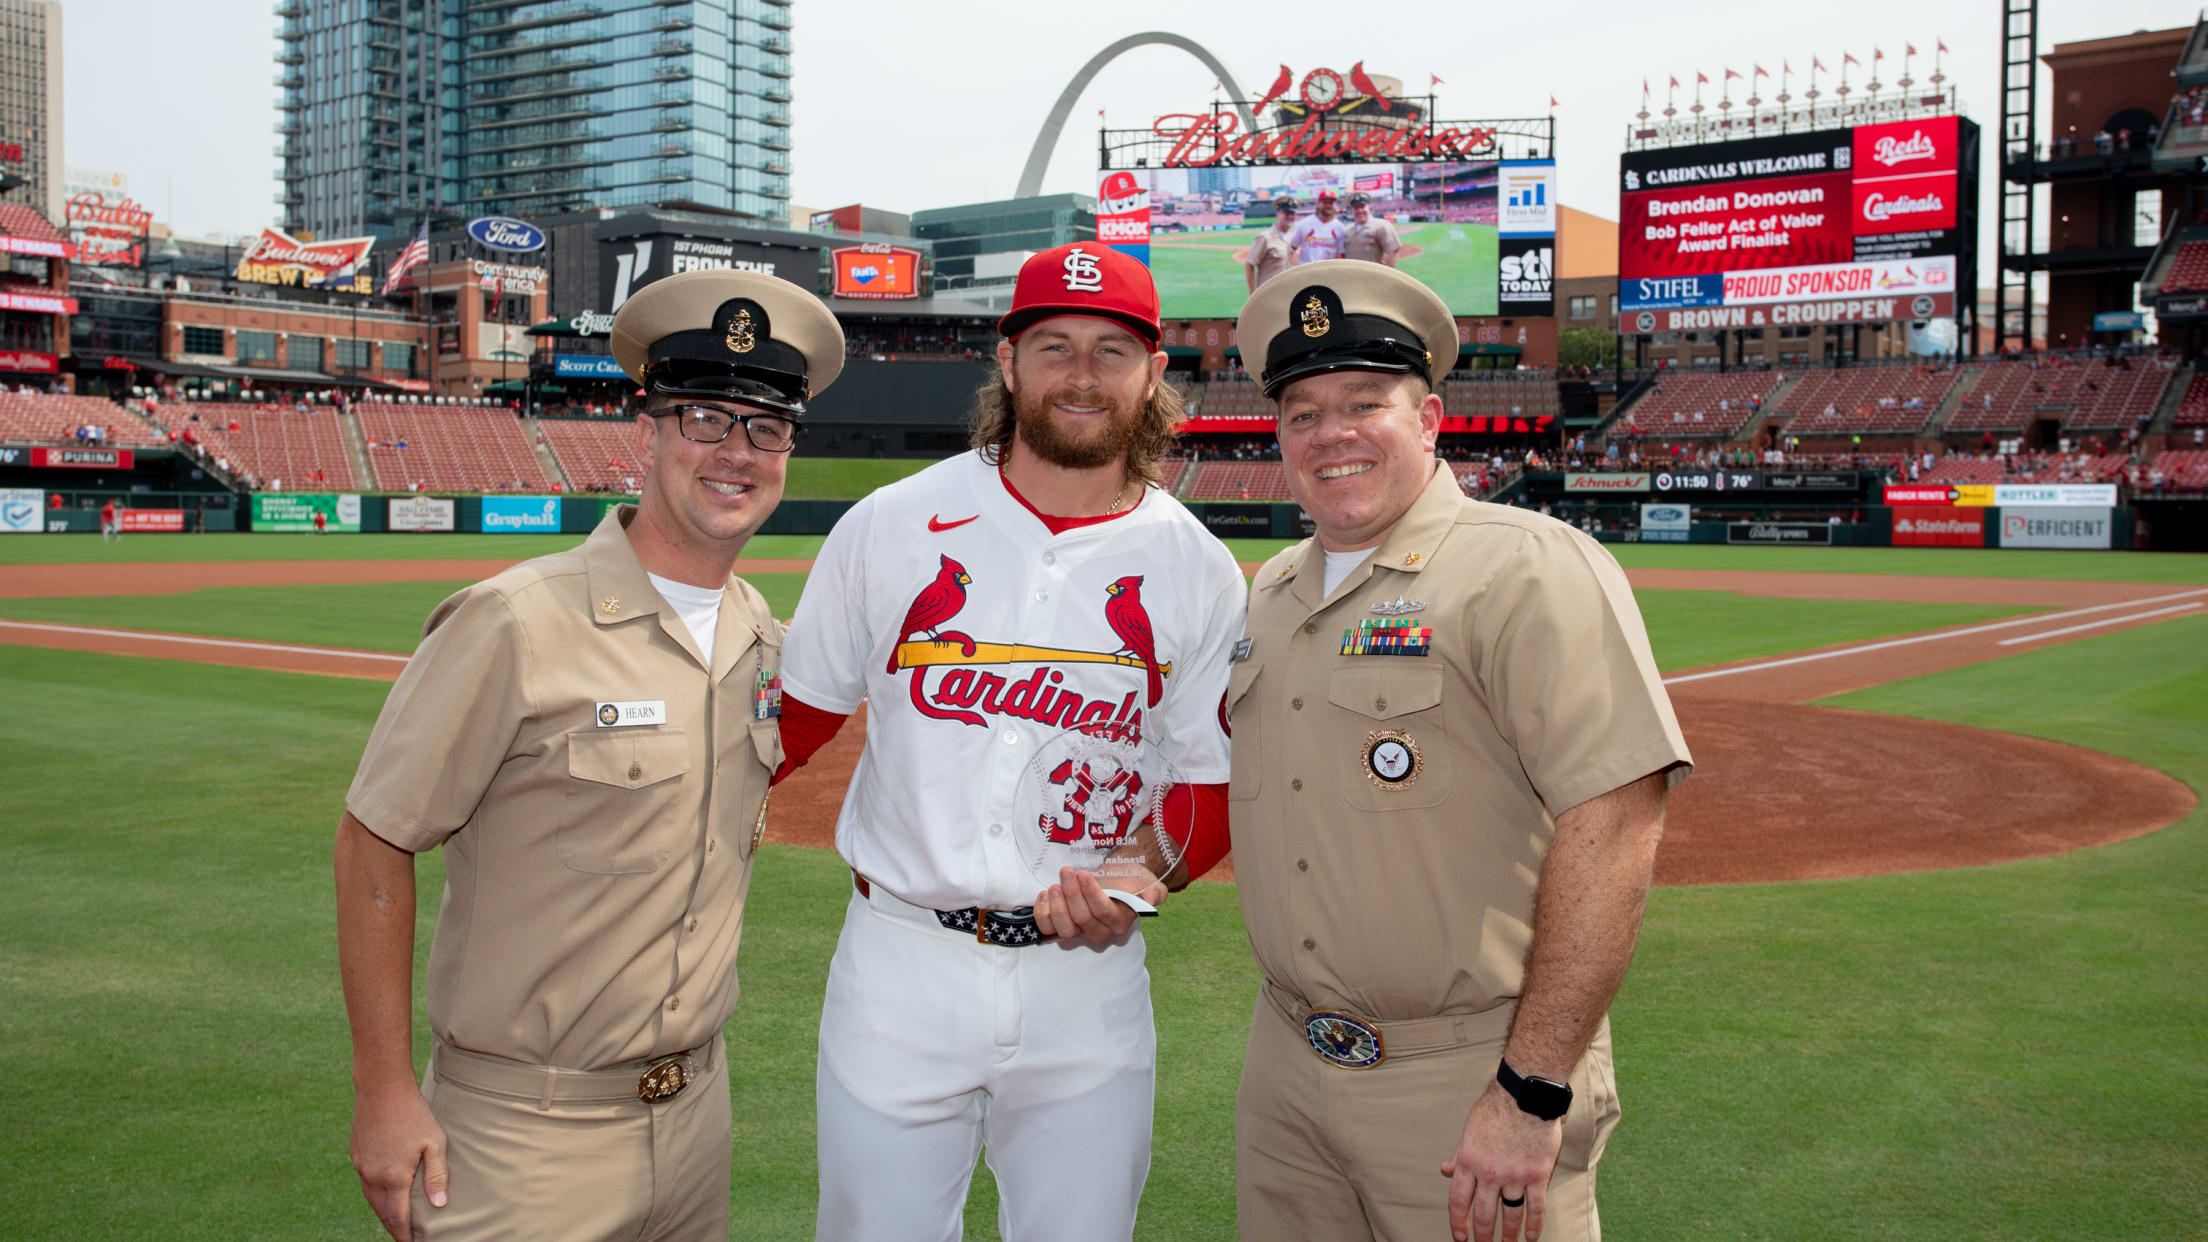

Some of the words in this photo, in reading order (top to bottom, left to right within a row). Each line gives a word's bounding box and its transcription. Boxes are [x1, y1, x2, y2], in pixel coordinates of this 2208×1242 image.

[1656, 117, 1749, 141] WORLD
[1754, 99, 1922, 130] CHAMPIONS
[1154, 111, 1497, 167] Budweiser
[1873, 129, 1936, 164] Reds
[1645, 164, 1738, 185] CARDINALS
[1740, 153, 1826, 176] WELCOME
[66, 192, 153, 236] Bally
[1530, 208, 1547, 216] Mid
[1648, 195, 1729, 217] Brendan
[1733, 187, 1824, 209] Donovan
[1863, 192, 1943, 221] Cardinals
[484, 219, 531, 247] Ford
[1099, 222, 1149, 235] KMOX
[1645, 225, 1677, 240] Bob
[1680, 220, 1725, 237] Feller
[1728, 217, 1756, 234] Act
[1759, 213, 1778, 231] of
[1781, 212, 1825, 229] Valor
[81, 241, 142, 267] Live!
[674, 240, 691, 253] 1ST
[691, 242, 734, 257] PHORM
[1677, 235, 1728, 254] Award
[1731, 231, 1790, 249] Finalist
[237, 261, 299, 286] BREW
[672, 253, 732, 275] FROM
[735, 260, 776, 276] THE
[1500, 247, 1552, 281] stl
[1500, 281, 1552, 292] TODAY
[1639, 277, 1704, 300] STIFEL
[1723, 274, 1783, 300] PROUD
[1786, 267, 1873, 296] SPONSOR
[1669, 307, 1746, 330] BROWN
[1751, 308, 1765, 325] &
[1771, 299, 1893, 324] CROUPPEN
[1185, 328, 1197, 346] 6
[1207, 328, 1219, 346] 9
[63, 451, 116, 463] PURINA
[1569, 476, 1648, 489] Schnucks
[1675, 475, 1708, 488] 11:50
[1731, 475, 1753, 488] 76°
[1206, 515, 1269, 525] HeGetsUs.com
[625, 706, 655, 719] HEARN
[909, 663, 1144, 749] Cardinals
[1039, 758, 1144, 851] 33
